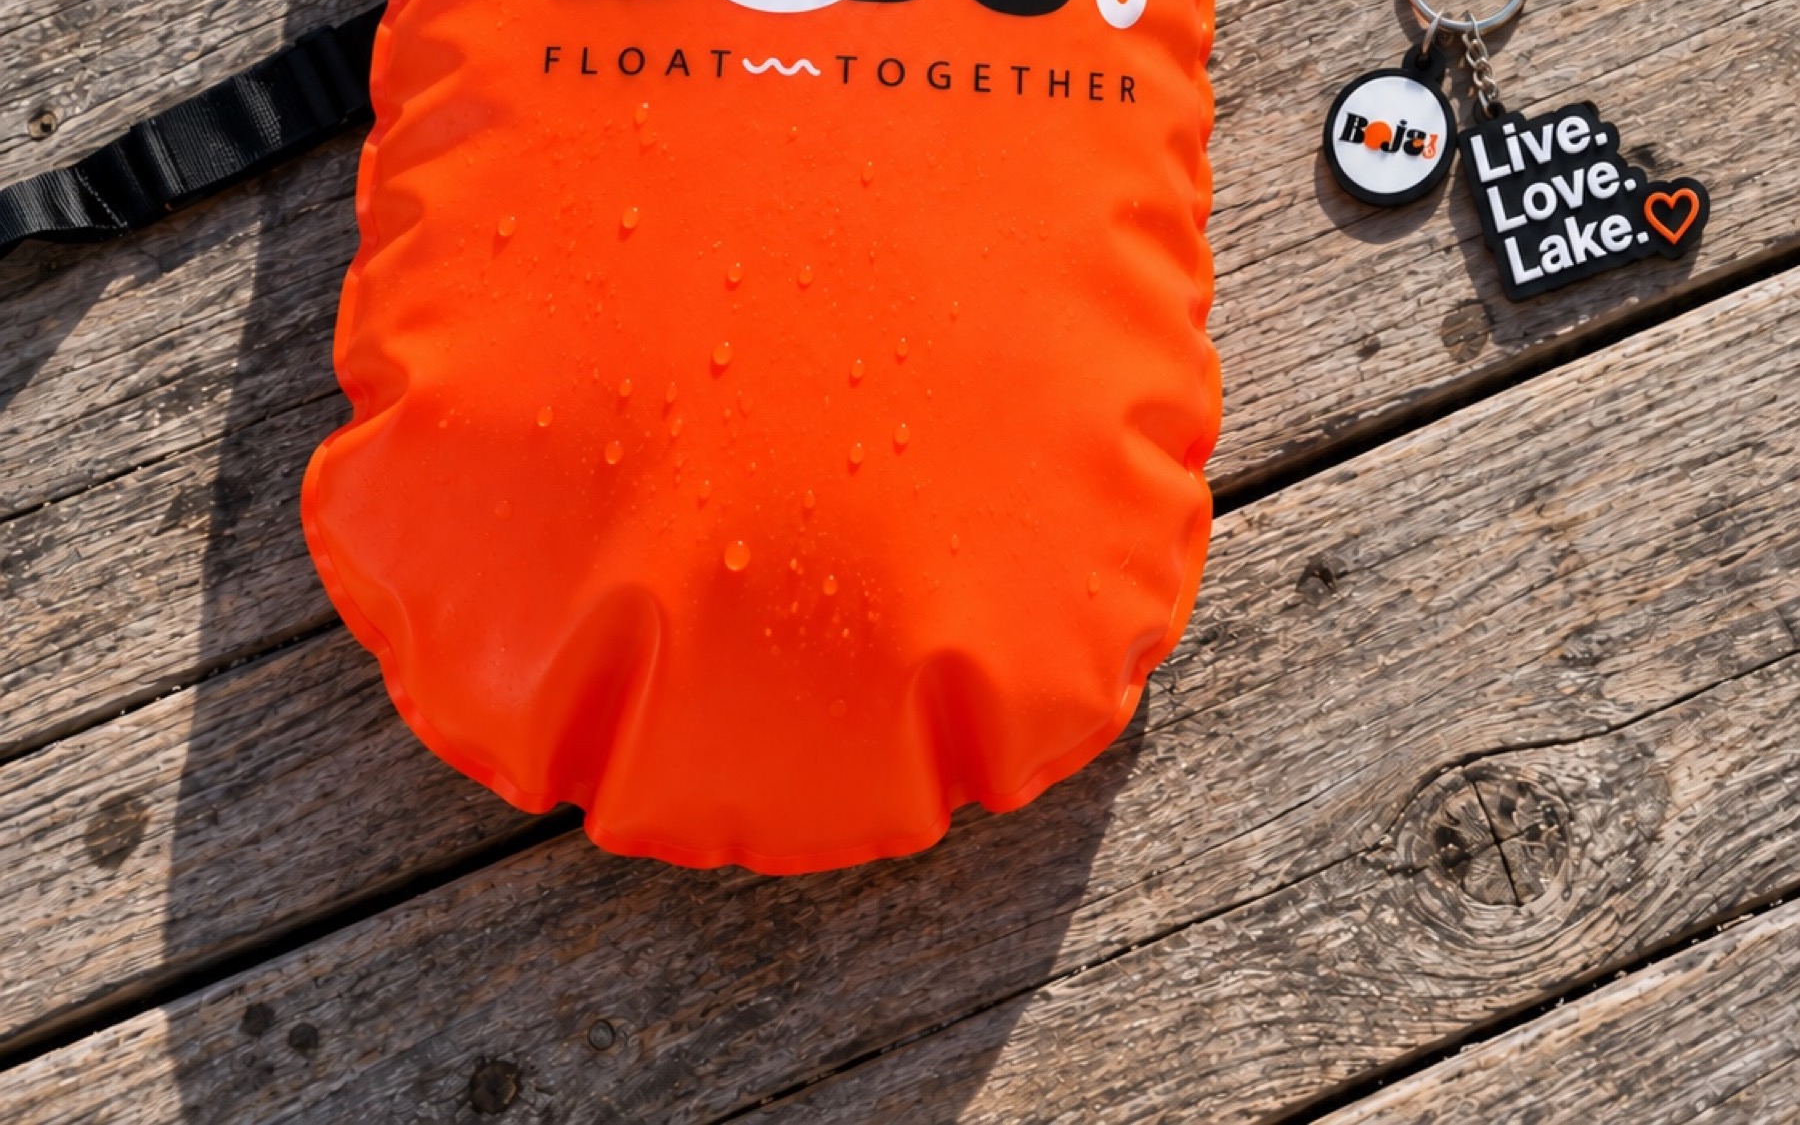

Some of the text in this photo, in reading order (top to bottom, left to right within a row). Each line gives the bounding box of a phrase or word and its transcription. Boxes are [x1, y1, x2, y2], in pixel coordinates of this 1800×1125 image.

[544, 46, 1136, 103] FLOAT TOGETHER
[1469, 115, 1609, 183] Live.
[1485, 161, 1637, 233] Love.
[1504, 214, 1650, 285] Lake.
